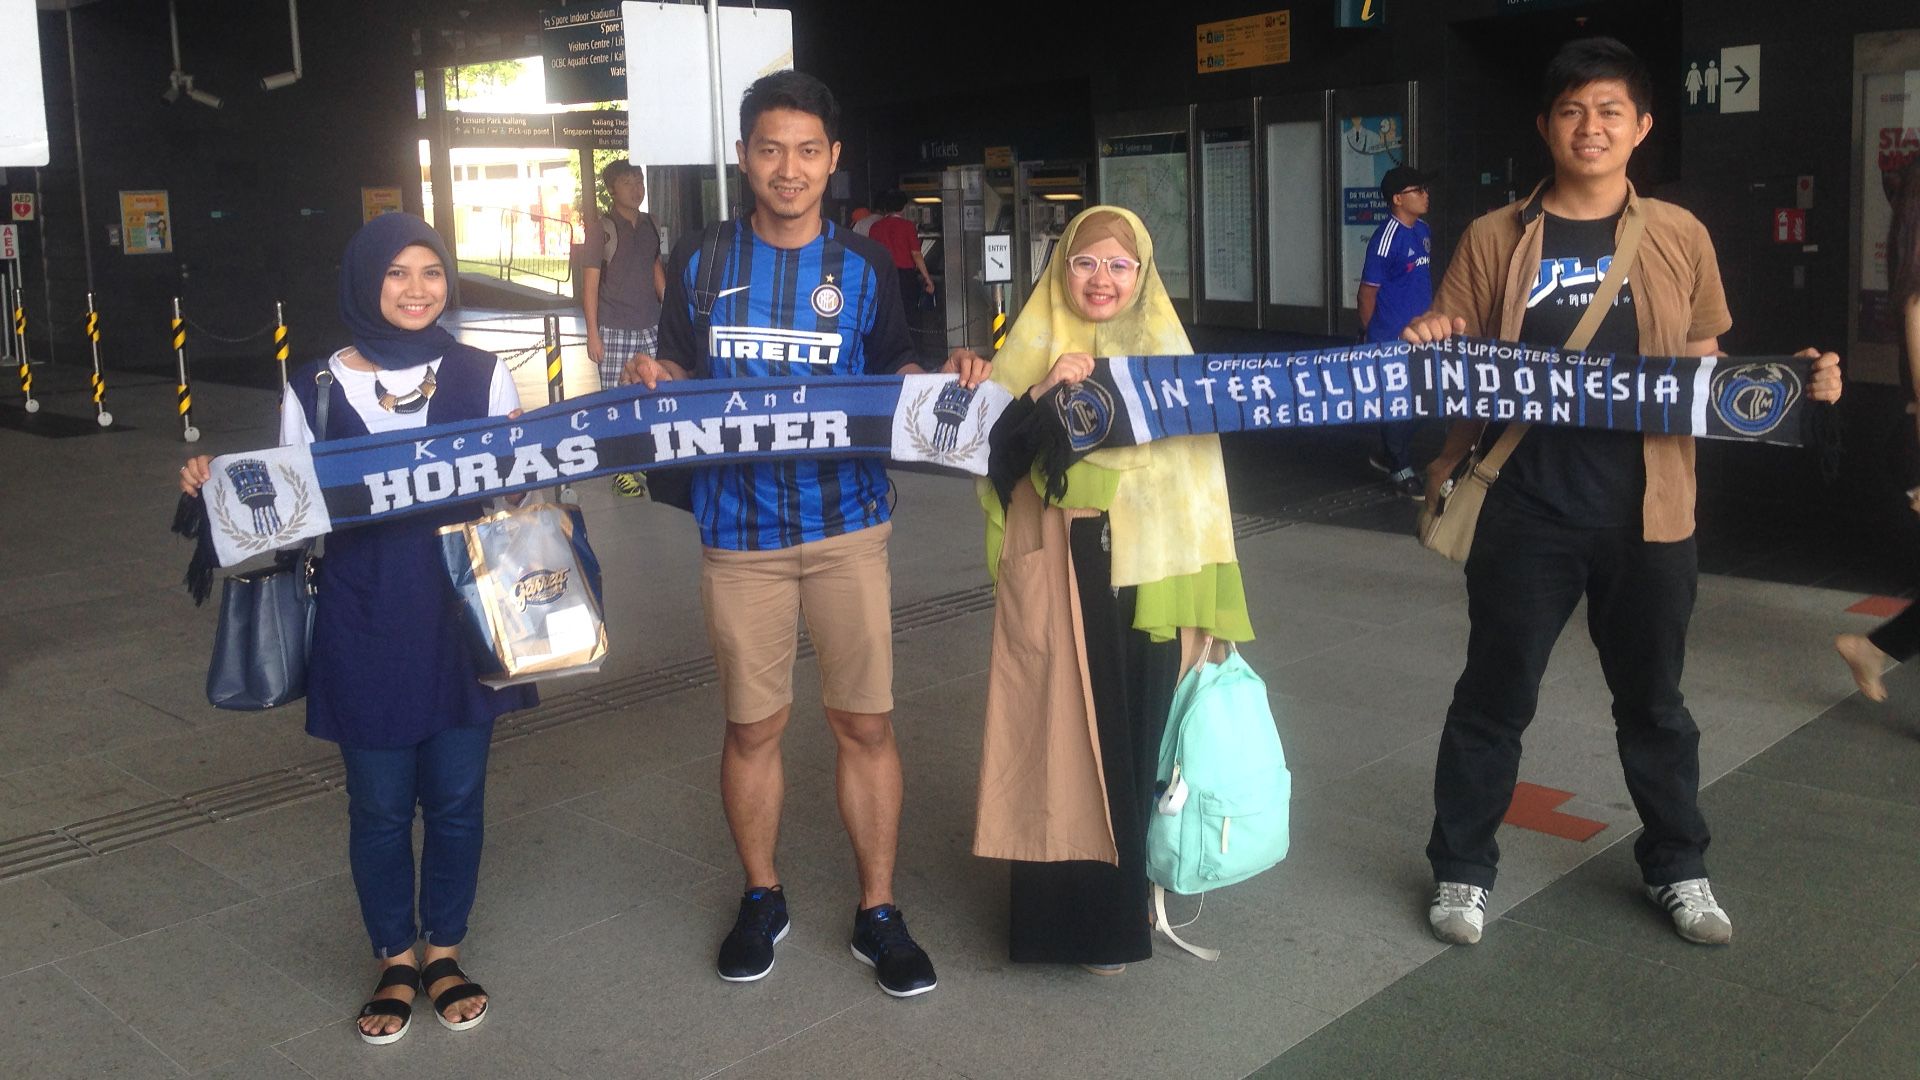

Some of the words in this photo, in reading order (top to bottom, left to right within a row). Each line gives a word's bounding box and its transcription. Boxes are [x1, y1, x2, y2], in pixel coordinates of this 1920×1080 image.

[570, 12, 589, 23] Indoor
[590, 8, 615, 20] Stadium
[601, 22, 619, 35] S'pore
[568, 41, 590, 52] Visitors
[590, 39, 610, 50] Centre
[616, 35, 624, 46] Lib
[567, 55, 589, 68] Aquatic
[590, 53, 609, 64] Centre
[614, 50, 624, 61] Kal
[610, 67, 625, 77] Wate
[462, 117, 486, 125] Leisure
[487, 117, 500, 125] Park
[502, 117, 527, 126] Kallang
[508, 127, 532, 136] Pick-up
[533, 127, 550, 136] point
[562, 128, 592, 136] Singapore
[593, 127, 613, 135] Indoor
[614, 128, 629, 136] Stadi
[1879, 127, 1920, 149] STA
[930, 141, 960, 159] Tickets
[14, 194, 31, 203] AED
[4, 226, 15, 257] AED
[988, 244, 1007, 252] ENTRY
[1207, 357, 1282, 371] OFFICIAL
[1286, 354, 1307, 368] FC
[1313, 339, 1453, 364] INTERNAZIONALE
[1457, 341, 1559, 363] SUPPORTERS
[1565, 352, 1612, 367] CLUB
[1142, 375, 1276, 411] INTER
[1297, 363, 1409, 397] CLUB
[1423, 358, 1681, 404] INDONESIA
[1253, 396, 1429, 425] REGIONAL
[1445, 398, 1571, 422] MEDAN
[414, 425, 524, 461] Keep
[570, 396, 678, 431] Calm
[725, 385, 807, 414] And
[362, 434, 600, 516] HORAS
[650, 410, 851, 462] INTER
